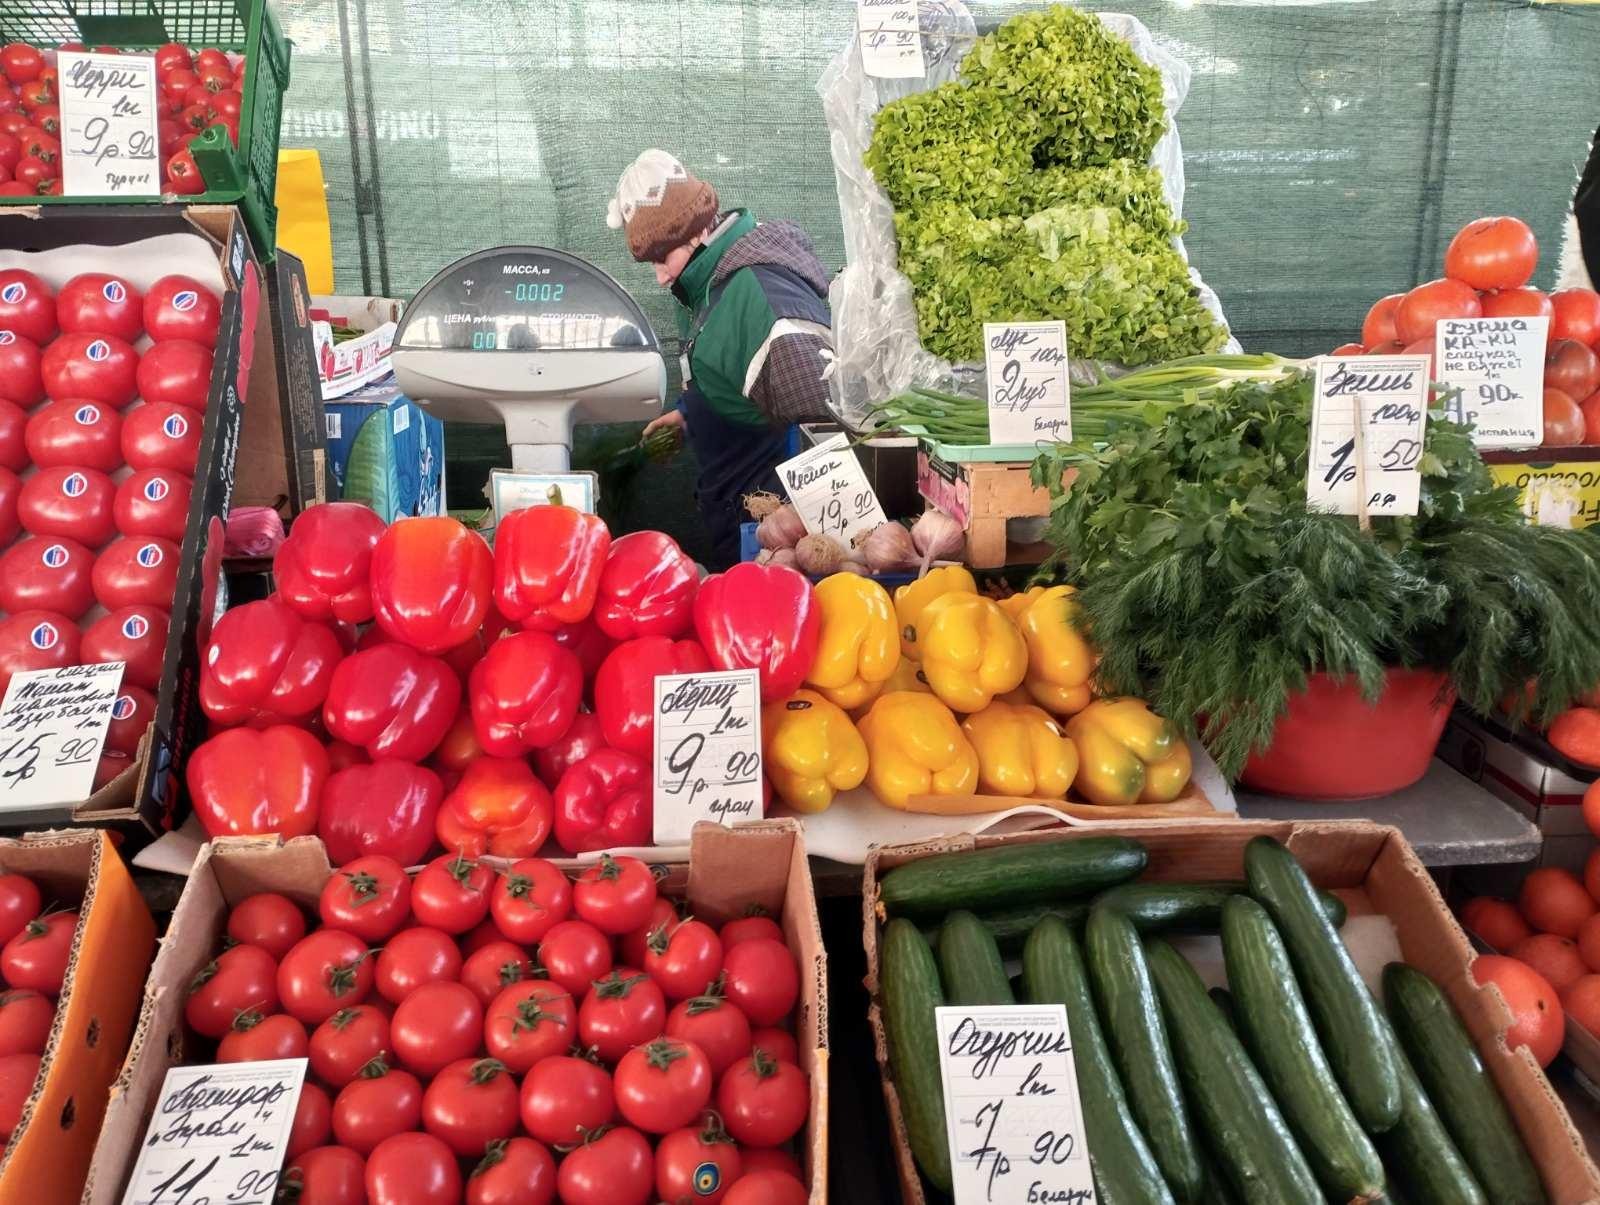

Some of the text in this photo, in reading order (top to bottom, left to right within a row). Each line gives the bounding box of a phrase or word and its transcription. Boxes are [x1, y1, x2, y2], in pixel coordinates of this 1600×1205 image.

[444, 314, 471, 324] ЦЕНА
[1379, 439, 1422, 468] 50
[786, 461, 842, 491] Чеснок
[854, 490, 873, 515] 90
[55, 737, 98, 763] 90
[725, 751, 760, 781] 90
[1030, 1131, 1074, 1164] 90
[227, 1169, 281, 1200] 90
